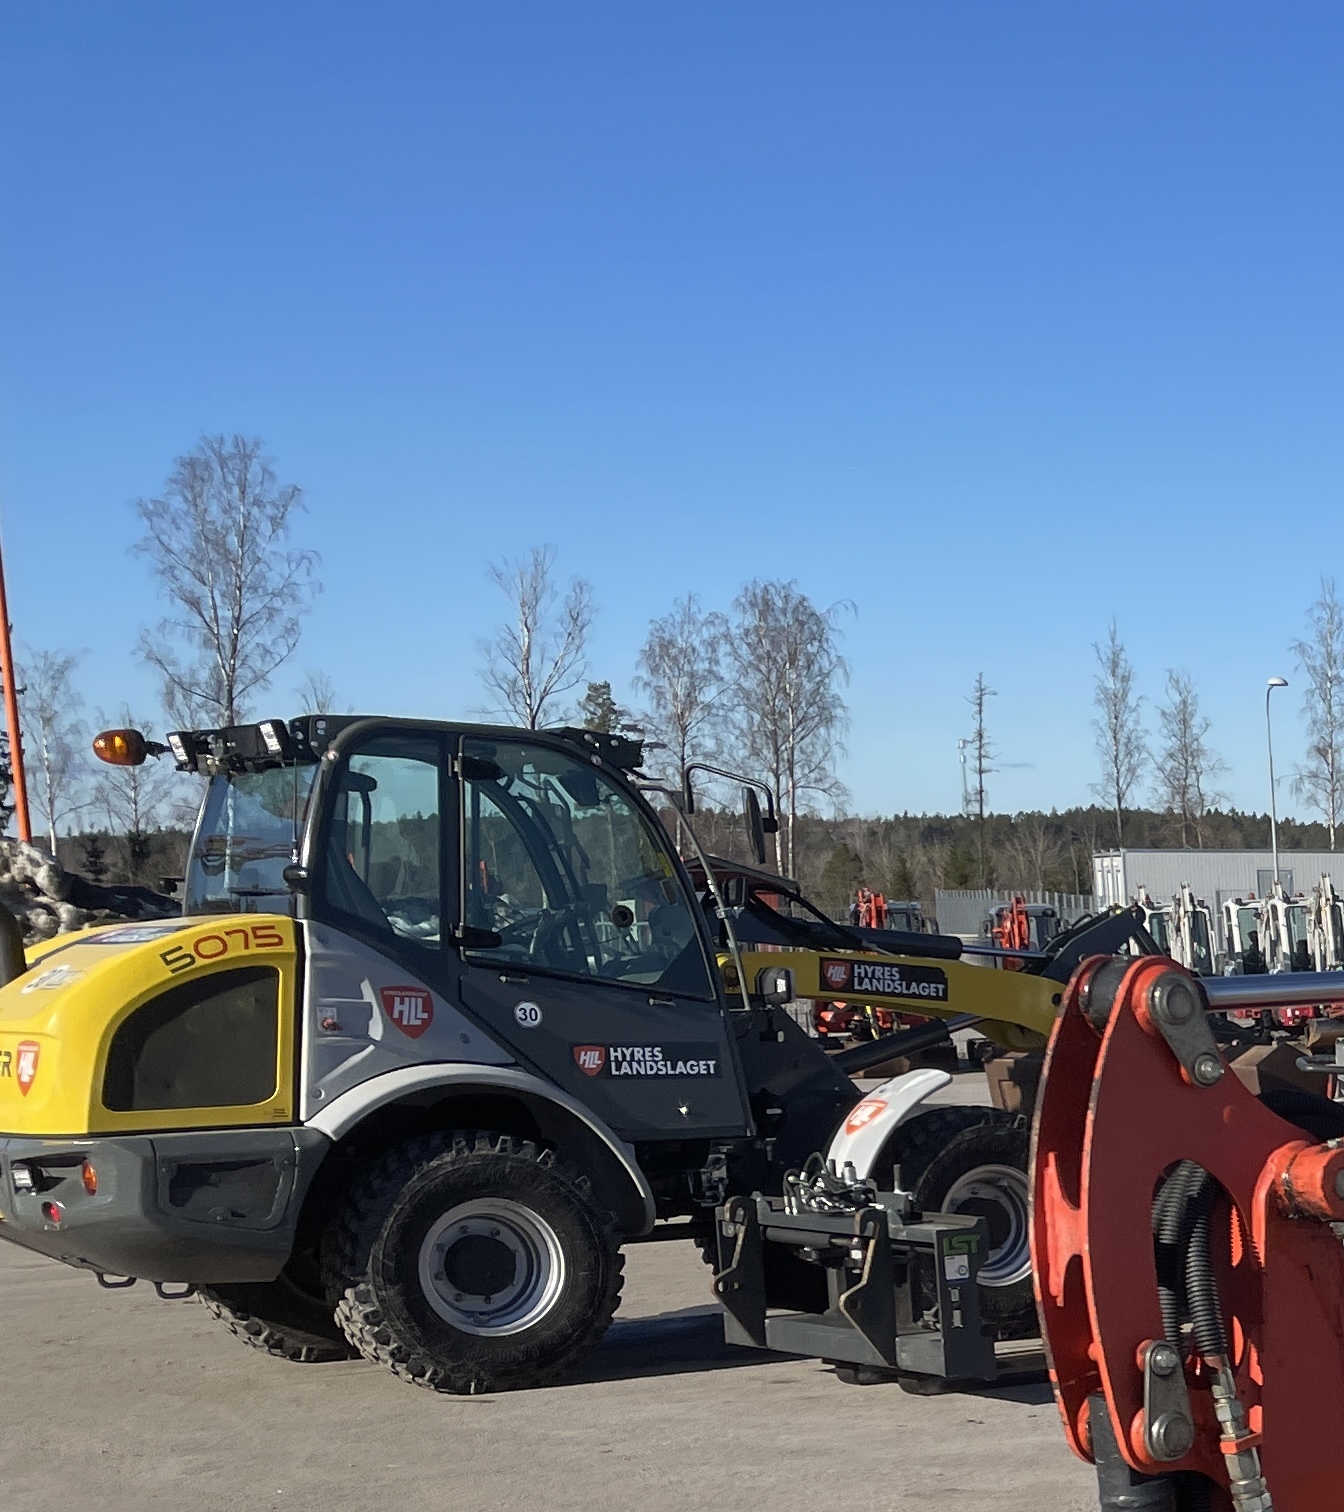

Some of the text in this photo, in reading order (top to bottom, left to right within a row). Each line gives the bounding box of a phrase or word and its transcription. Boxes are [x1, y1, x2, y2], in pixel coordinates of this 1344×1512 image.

[159, 925, 283, 974] 5075
[854, 964, 900, 980] HYRES
[854, 977, 945, 997] LANDSLAGET
[392, 996, 429, 1025] HLL
[518, 1007, 539, 1023] 30
[609, 1047, 663, 1062] HYRES
[611, 1060, 717, 1076] LANDSLAGET
[943, 1235, 980, 1254] LST
